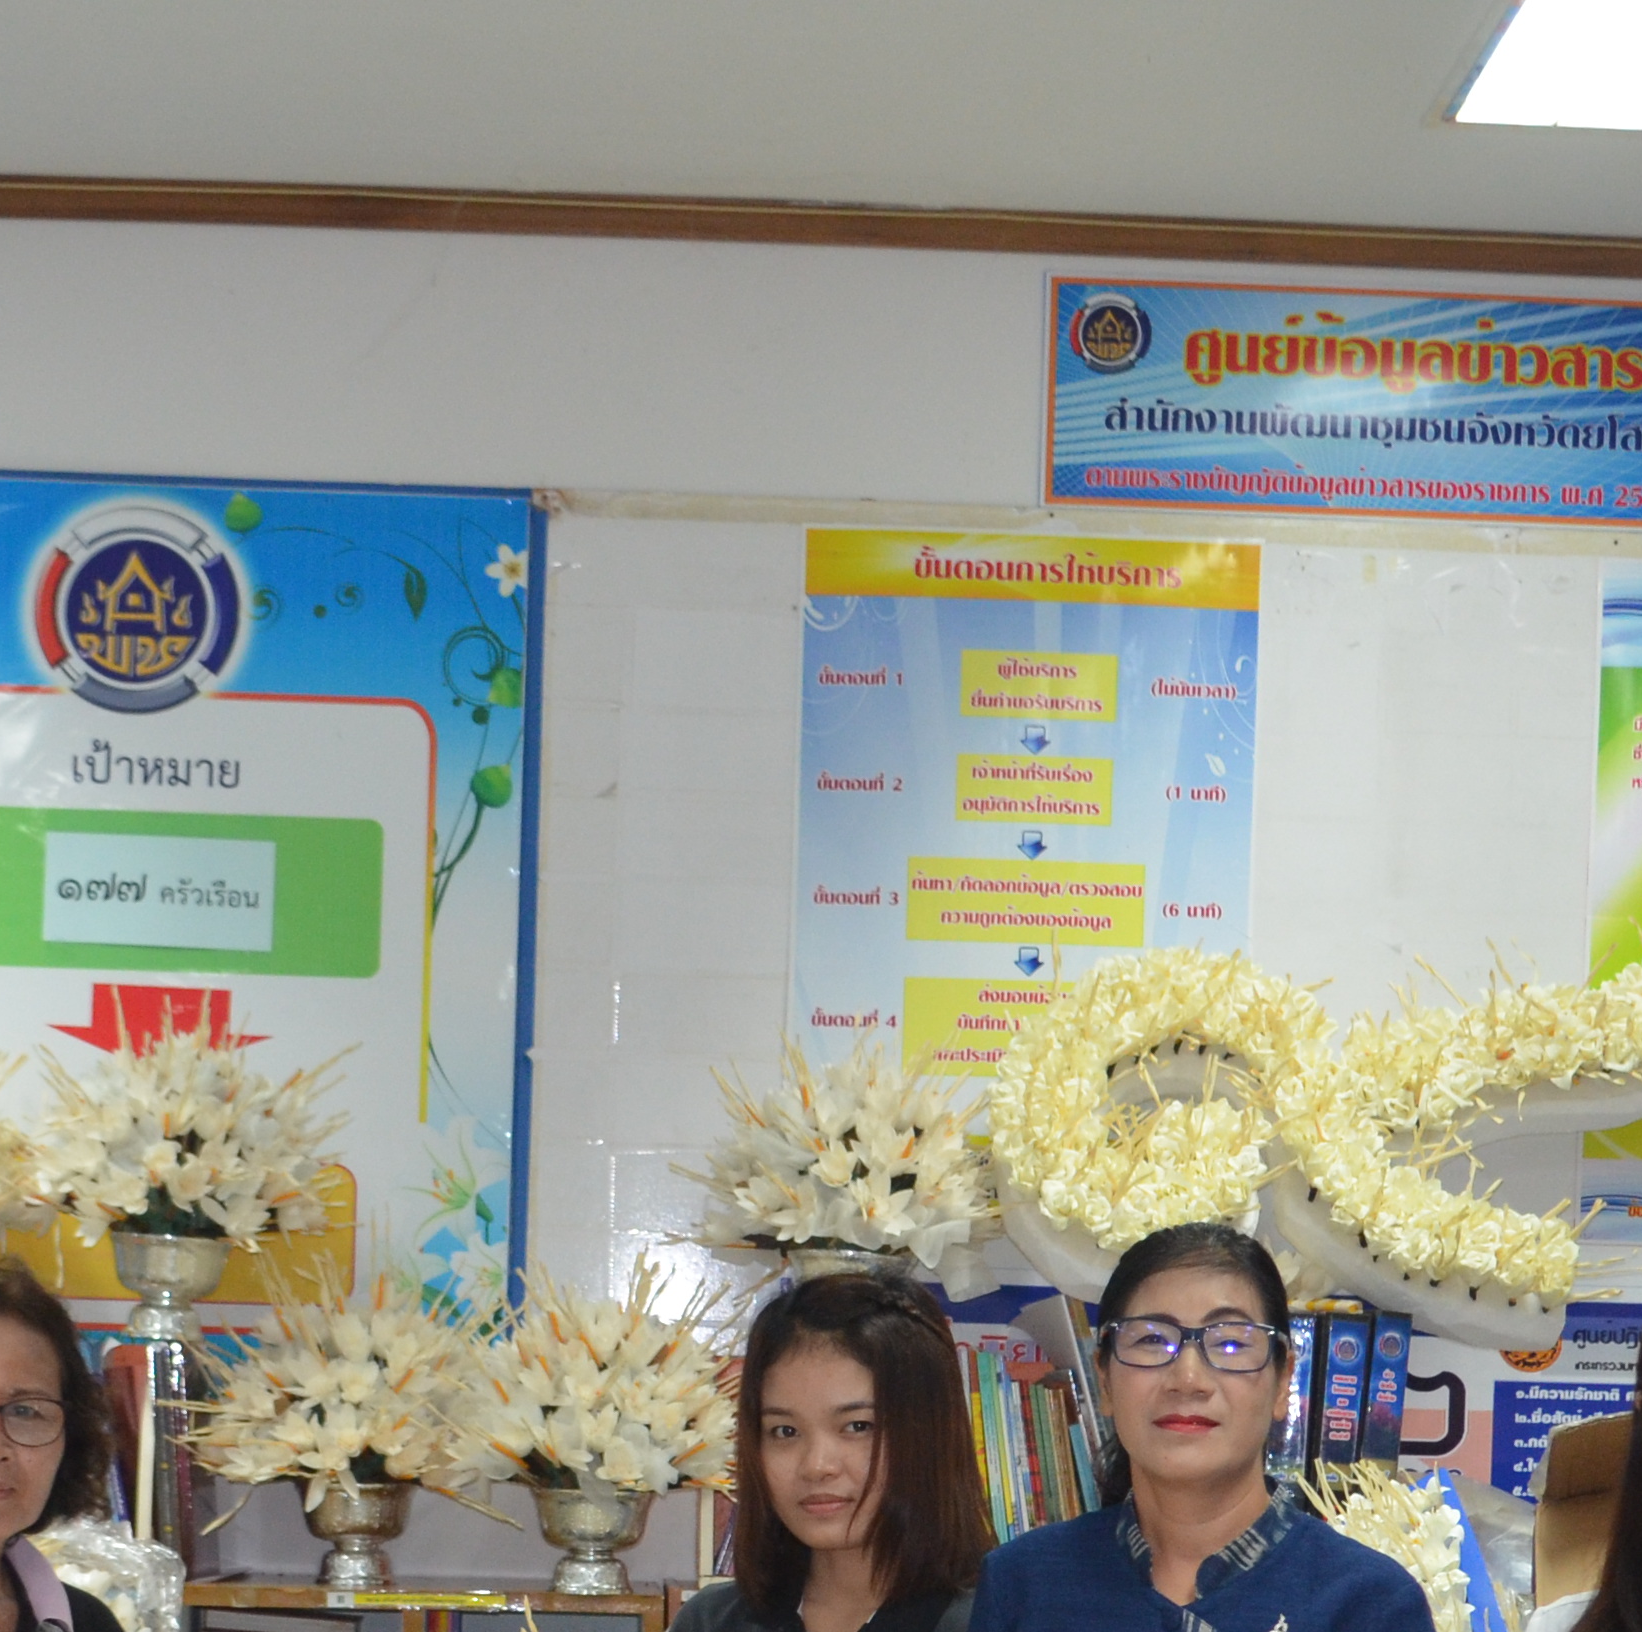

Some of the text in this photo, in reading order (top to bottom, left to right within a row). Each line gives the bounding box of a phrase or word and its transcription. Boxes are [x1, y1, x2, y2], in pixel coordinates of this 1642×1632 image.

[913, 545, 1182, 590] ขั้นตอนการให้บริการ
[818, 664, 904, 687] ขั้นตอนที่ 1
[70, 740, 242, 789] เป้าหมาย
[817, 769, 903, 792] ขั้นตอนที่ 2
[57, 872, 261, 911] ๑๗๗ ครัวเรือน
[813, 883, 900, 906] ขั้นตอนที่ 3
[1162, 902, 1180, 919] (6
[885, 1013, 898, 1028] 4
